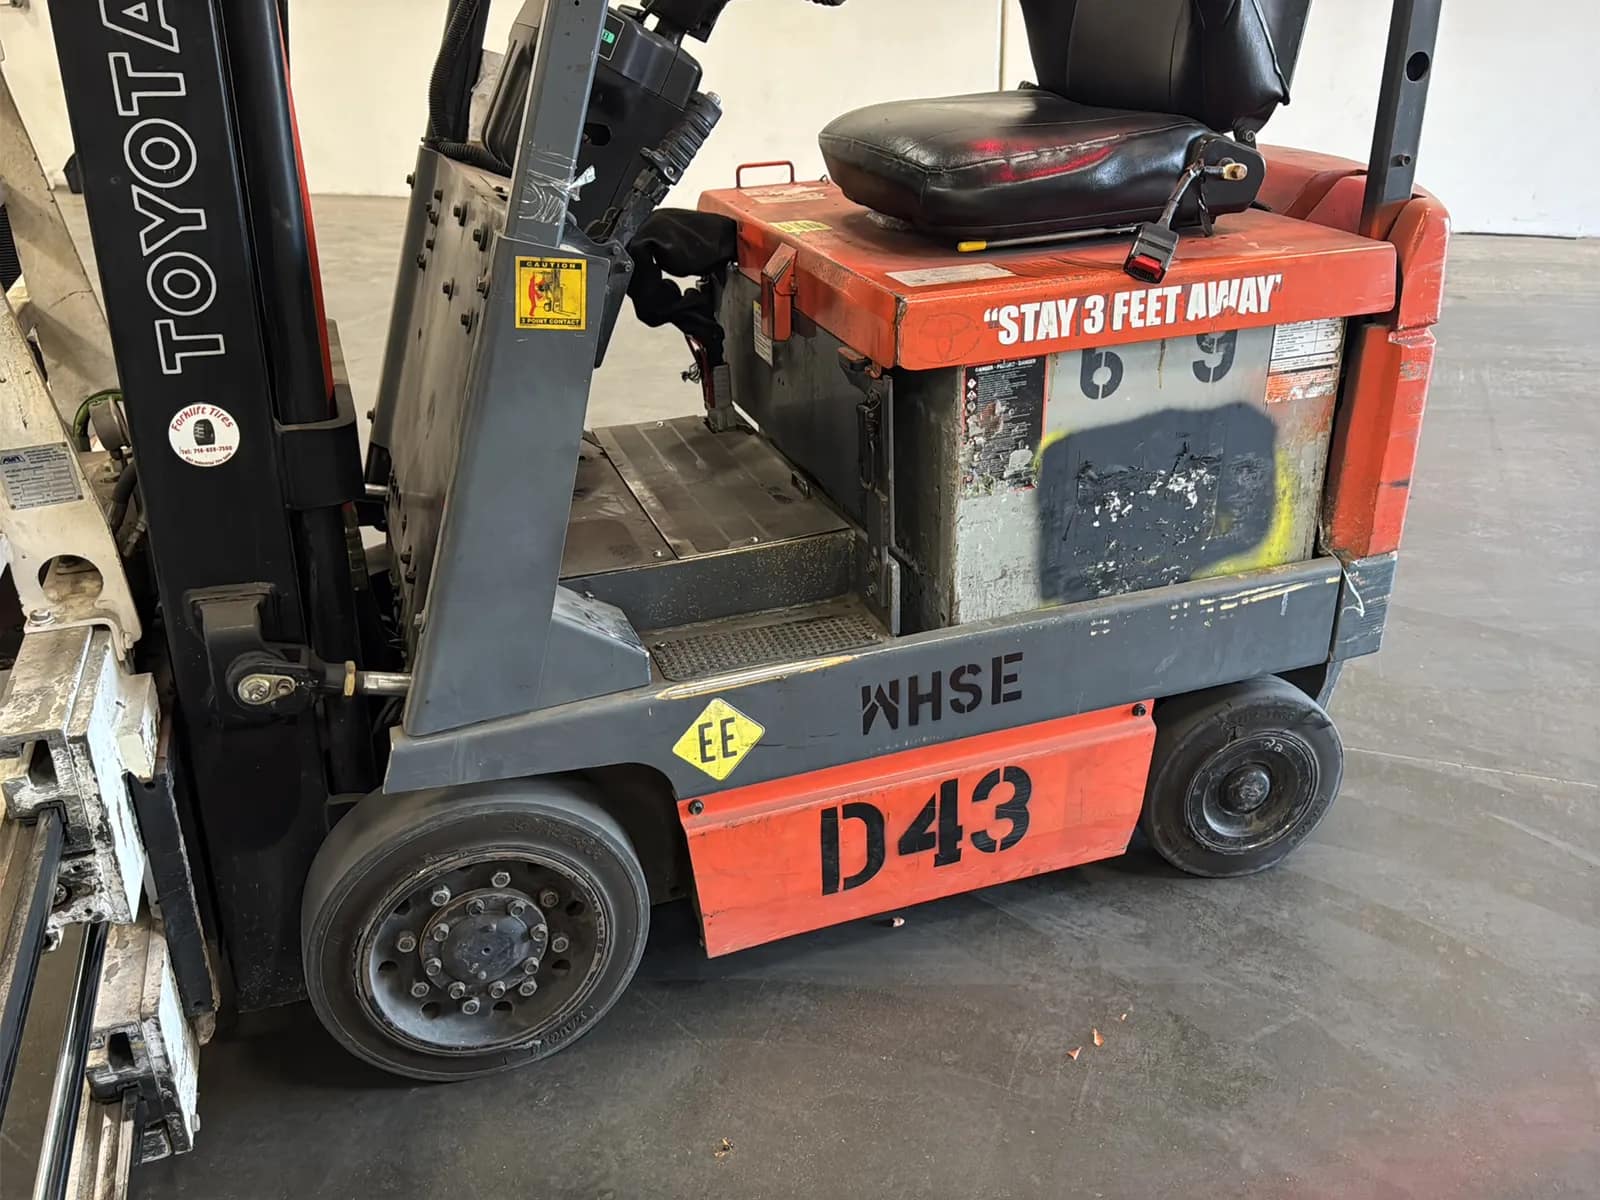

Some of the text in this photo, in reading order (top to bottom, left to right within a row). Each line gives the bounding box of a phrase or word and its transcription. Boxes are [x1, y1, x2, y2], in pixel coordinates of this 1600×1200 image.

[100, 0, 225, 374] TOYOTA
[1083, 293, 1107, 334] 3
[1112, 286, 1182, 330] FEET
[171, 406, 233, 432] Forklift Tires
[861, 651, 1024, 736] WHSE
[698, 716, 737, 764] EE
[821, 765, 1032, 896] D43
